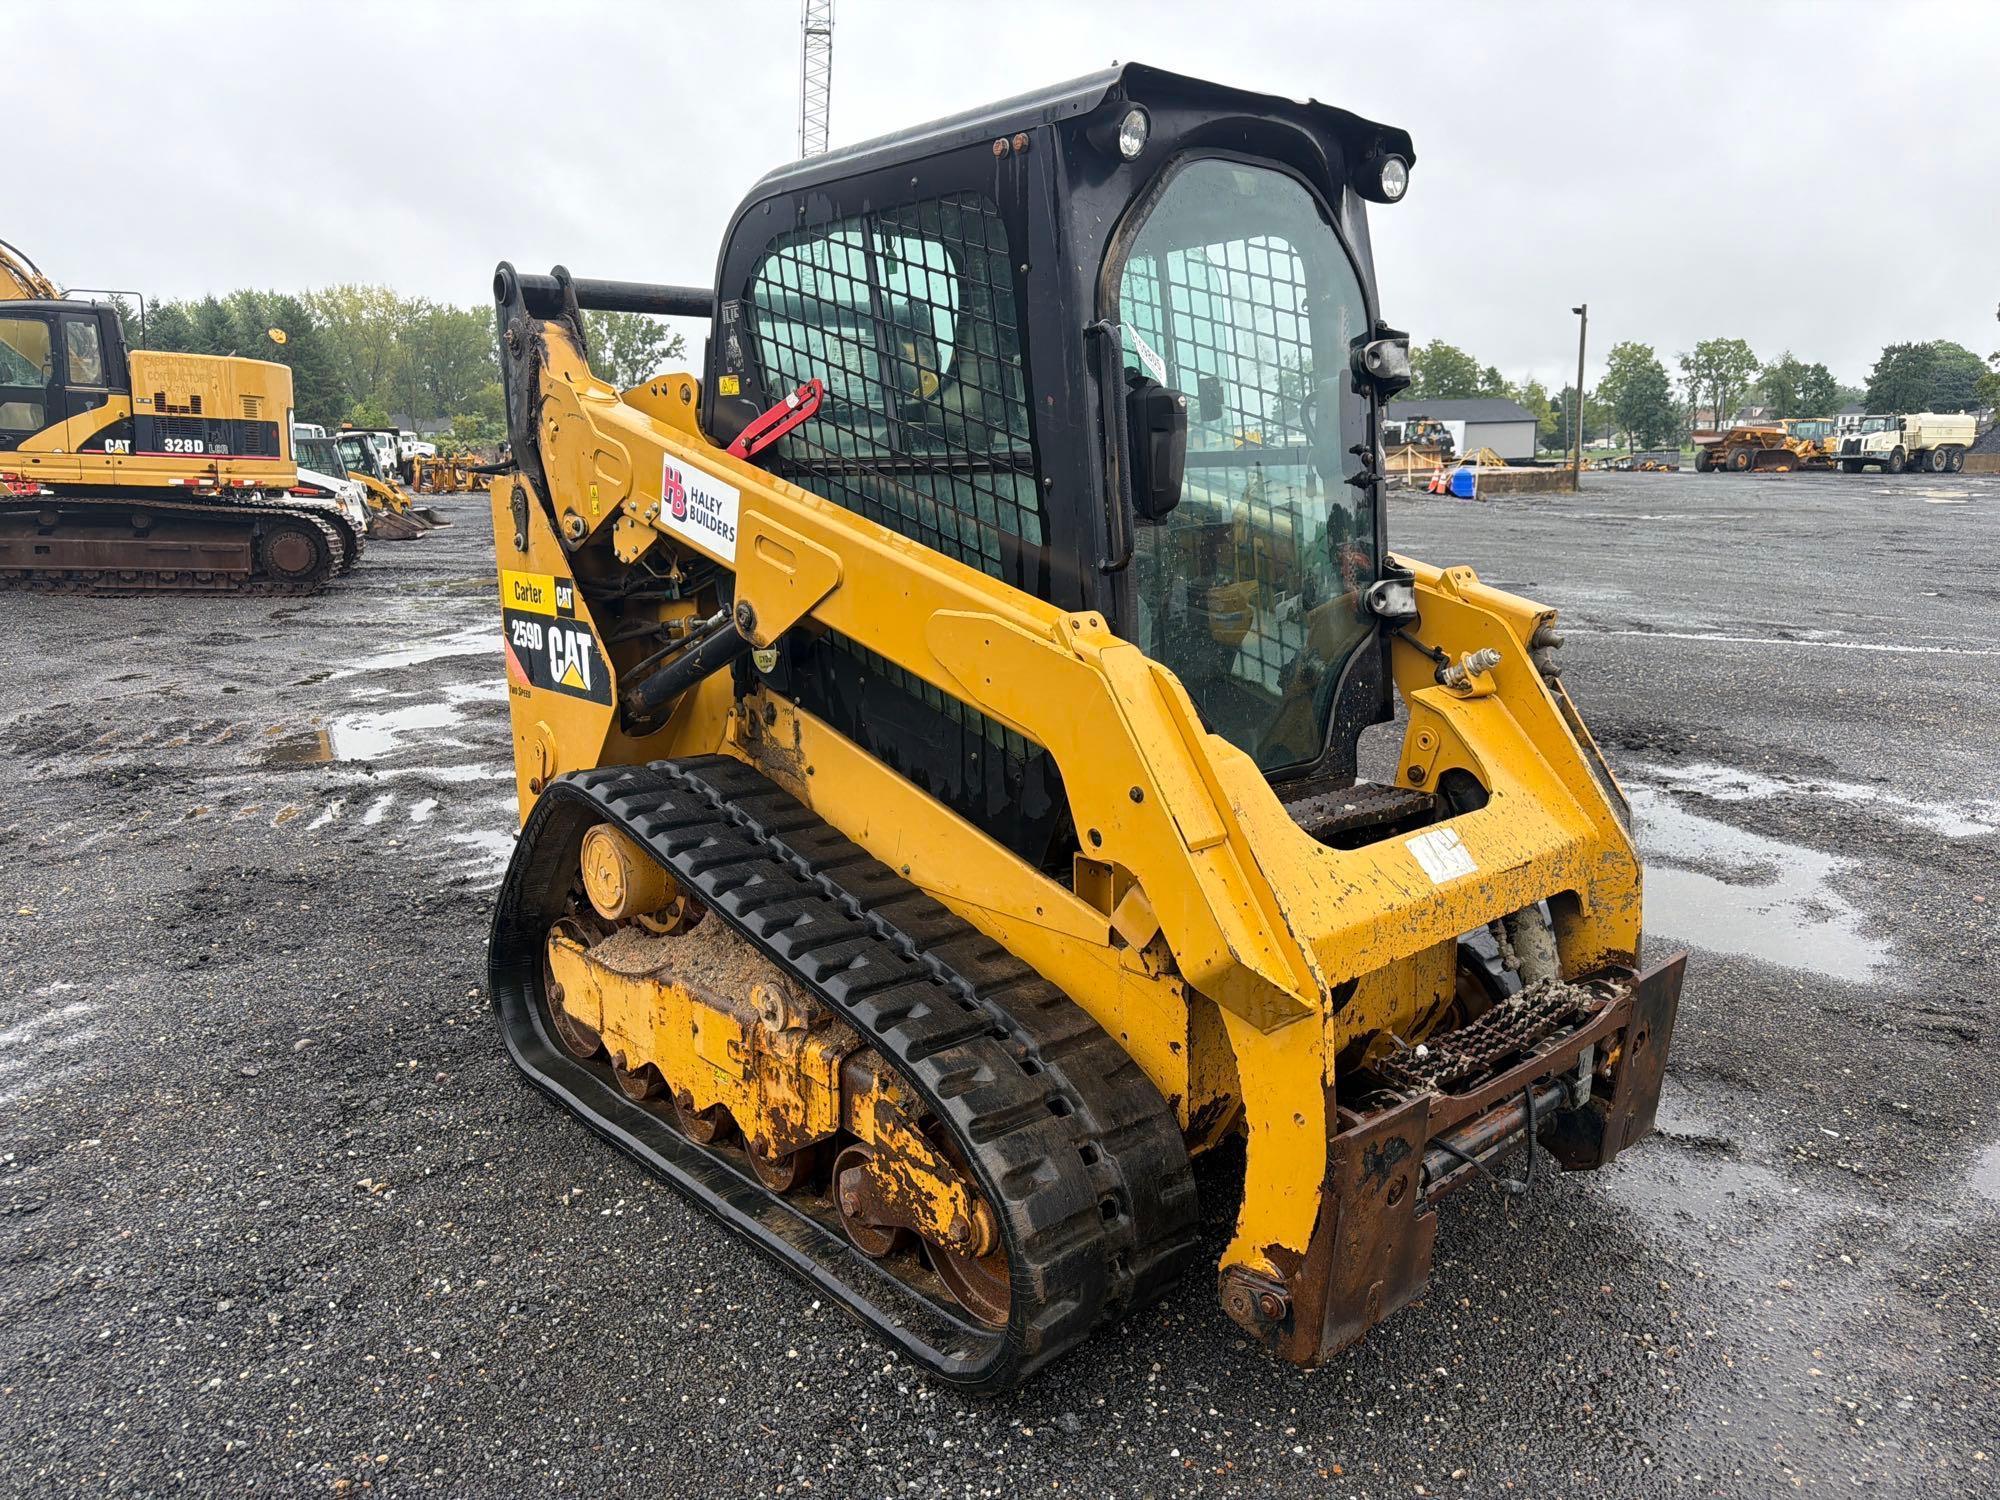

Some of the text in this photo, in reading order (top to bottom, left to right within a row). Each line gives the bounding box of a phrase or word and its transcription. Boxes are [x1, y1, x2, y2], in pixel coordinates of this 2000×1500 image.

[104, 438, 130, 454] CAT
[164, 438, 204, 453] 328D
[690, 486, 722, 516] HALEY
[689, 504, 735, 543] BUILDERS
[514, 580, 542, 604] Carter
[555, 586, 573, 609] CAT
[511, 619, 543, 651] 259D
[548, 626, 592, 691] CAT
